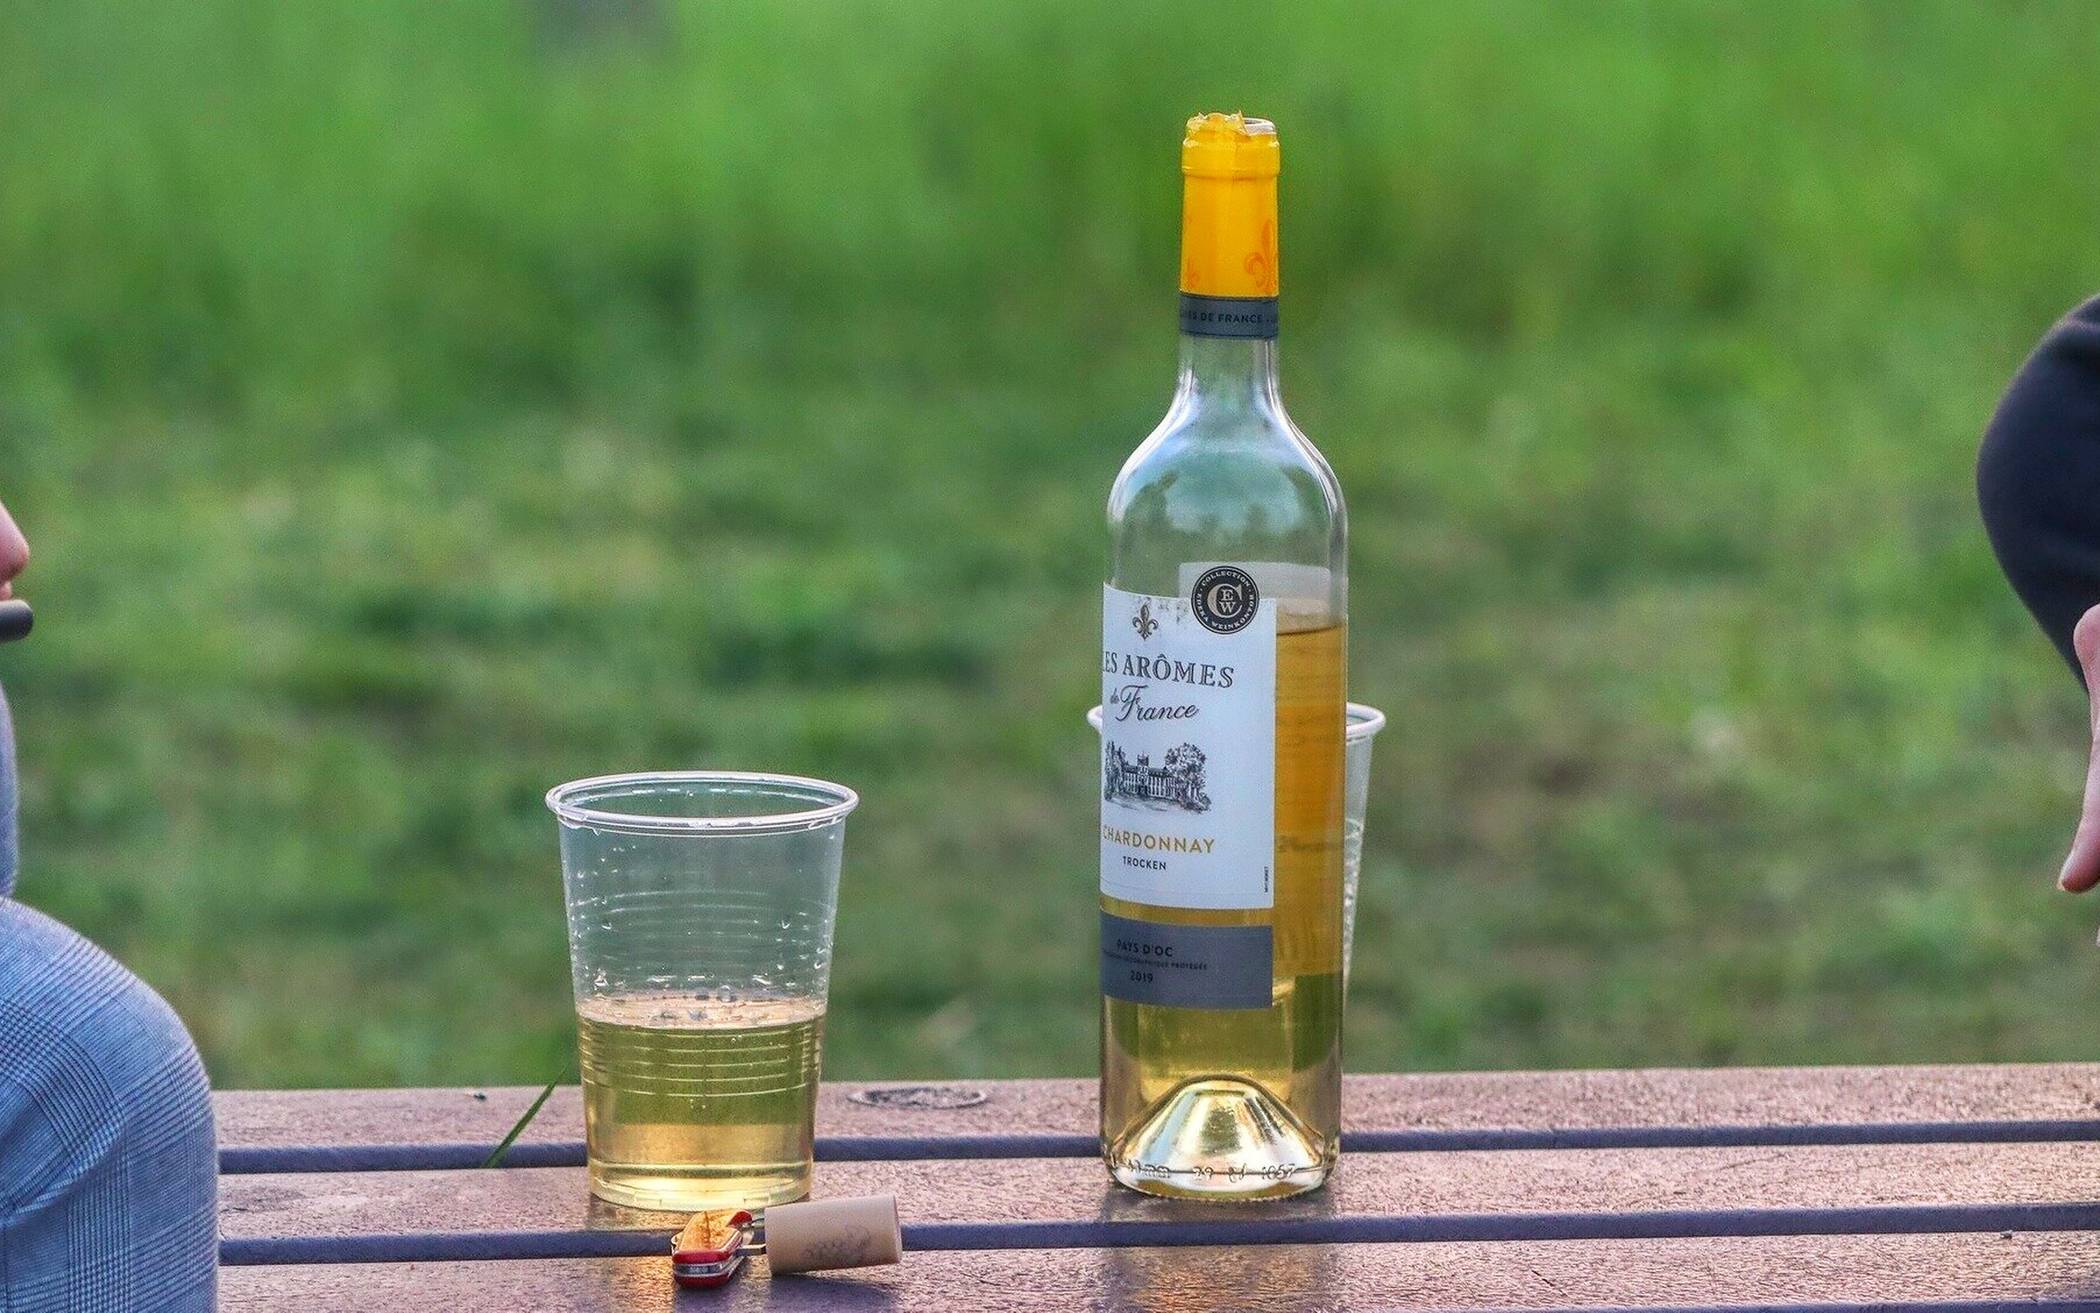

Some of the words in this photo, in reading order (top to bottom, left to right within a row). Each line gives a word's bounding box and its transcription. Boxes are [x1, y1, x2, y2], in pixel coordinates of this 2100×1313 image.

[1200, 312, 1214, 322] DE
[1217, 313, 1263, 324] FRANCE
[1201, 570, 1251, 588] COLLECTION
[1103, 651, 1118, 674] ES
[1122, 653, 1234, 689] ARÔMES
[1115, 684, 1199, 722] France
[1103, 824, 1215, 854] CHARDONNAY
[1122, 855, 1167, 871] TROCKEN
[1116, 938, 1139, 953] PAYS
[1142, 944, 1174, 957] D'OC
[1130, 970, 1153, 983] 2019
